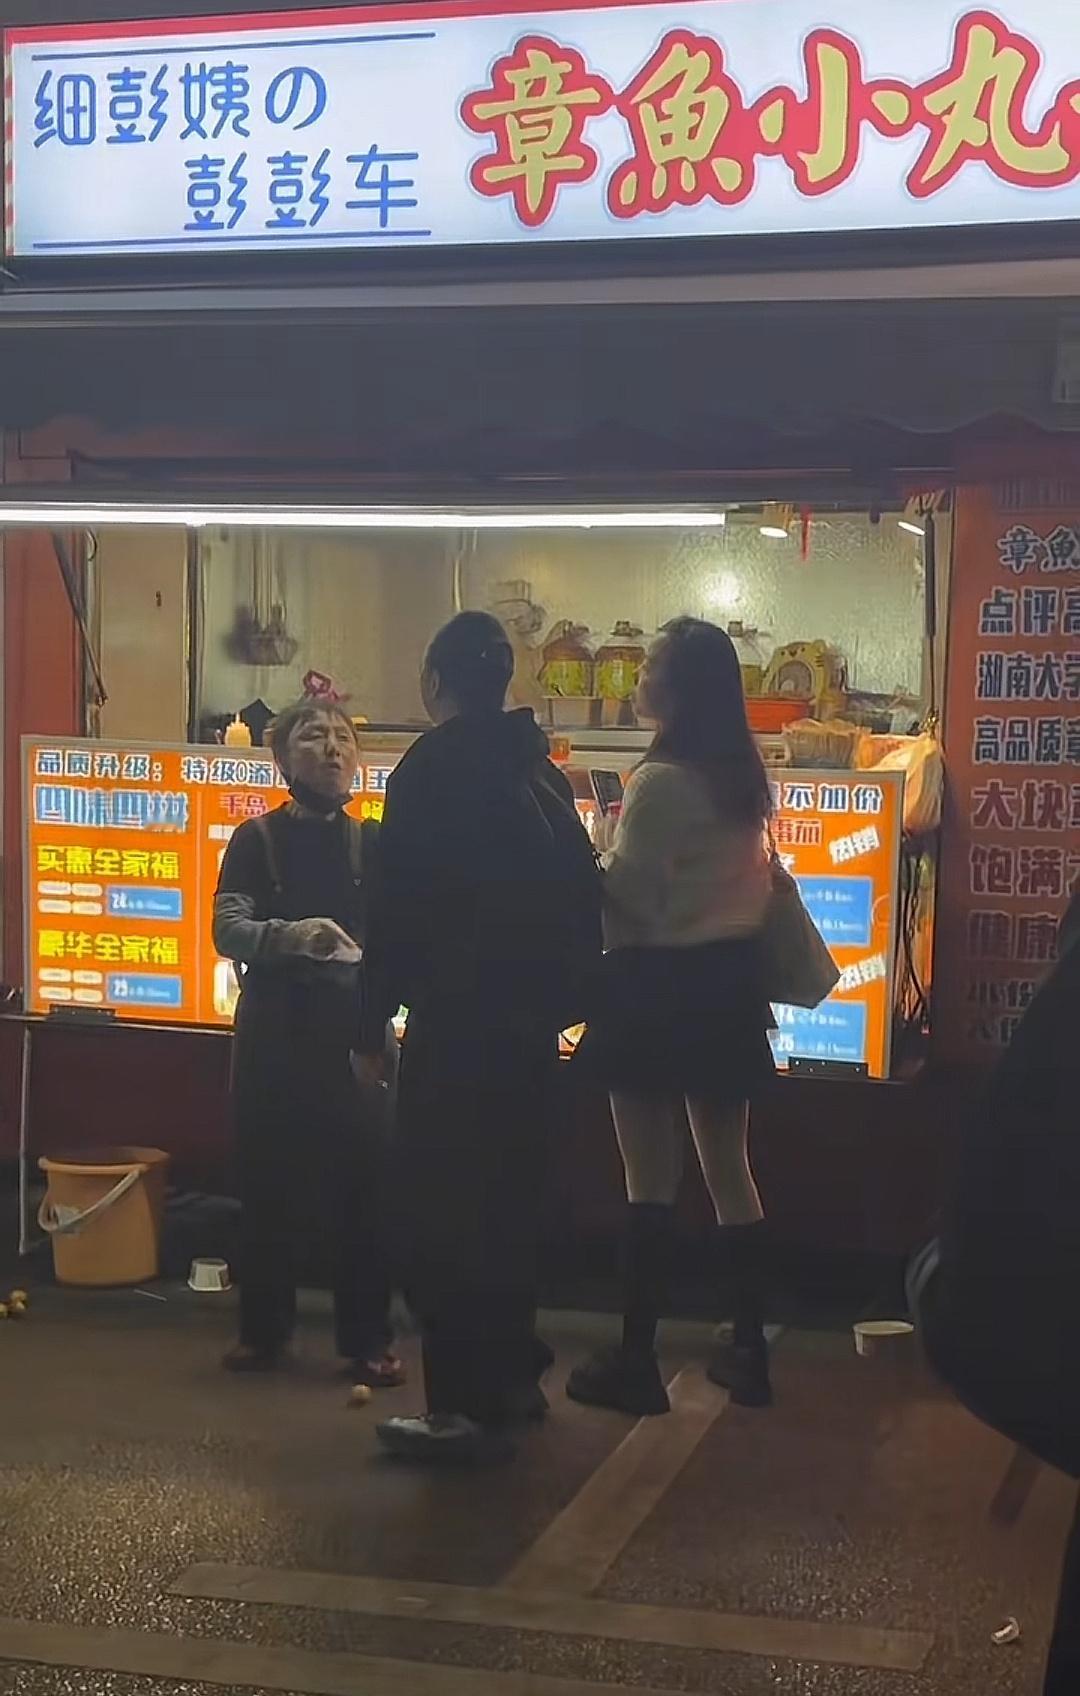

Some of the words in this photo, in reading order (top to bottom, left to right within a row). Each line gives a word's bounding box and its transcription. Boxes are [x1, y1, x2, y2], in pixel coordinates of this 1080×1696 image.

[34, 61, 327, 148] 细彭姨の
[460, 11, 1080, 226] 章魚小丸
[184, 145, 419, 231] 彭彭车
[971, 778, 1080, 831] 大块
[969, 844, 1080, 898] 饱满
